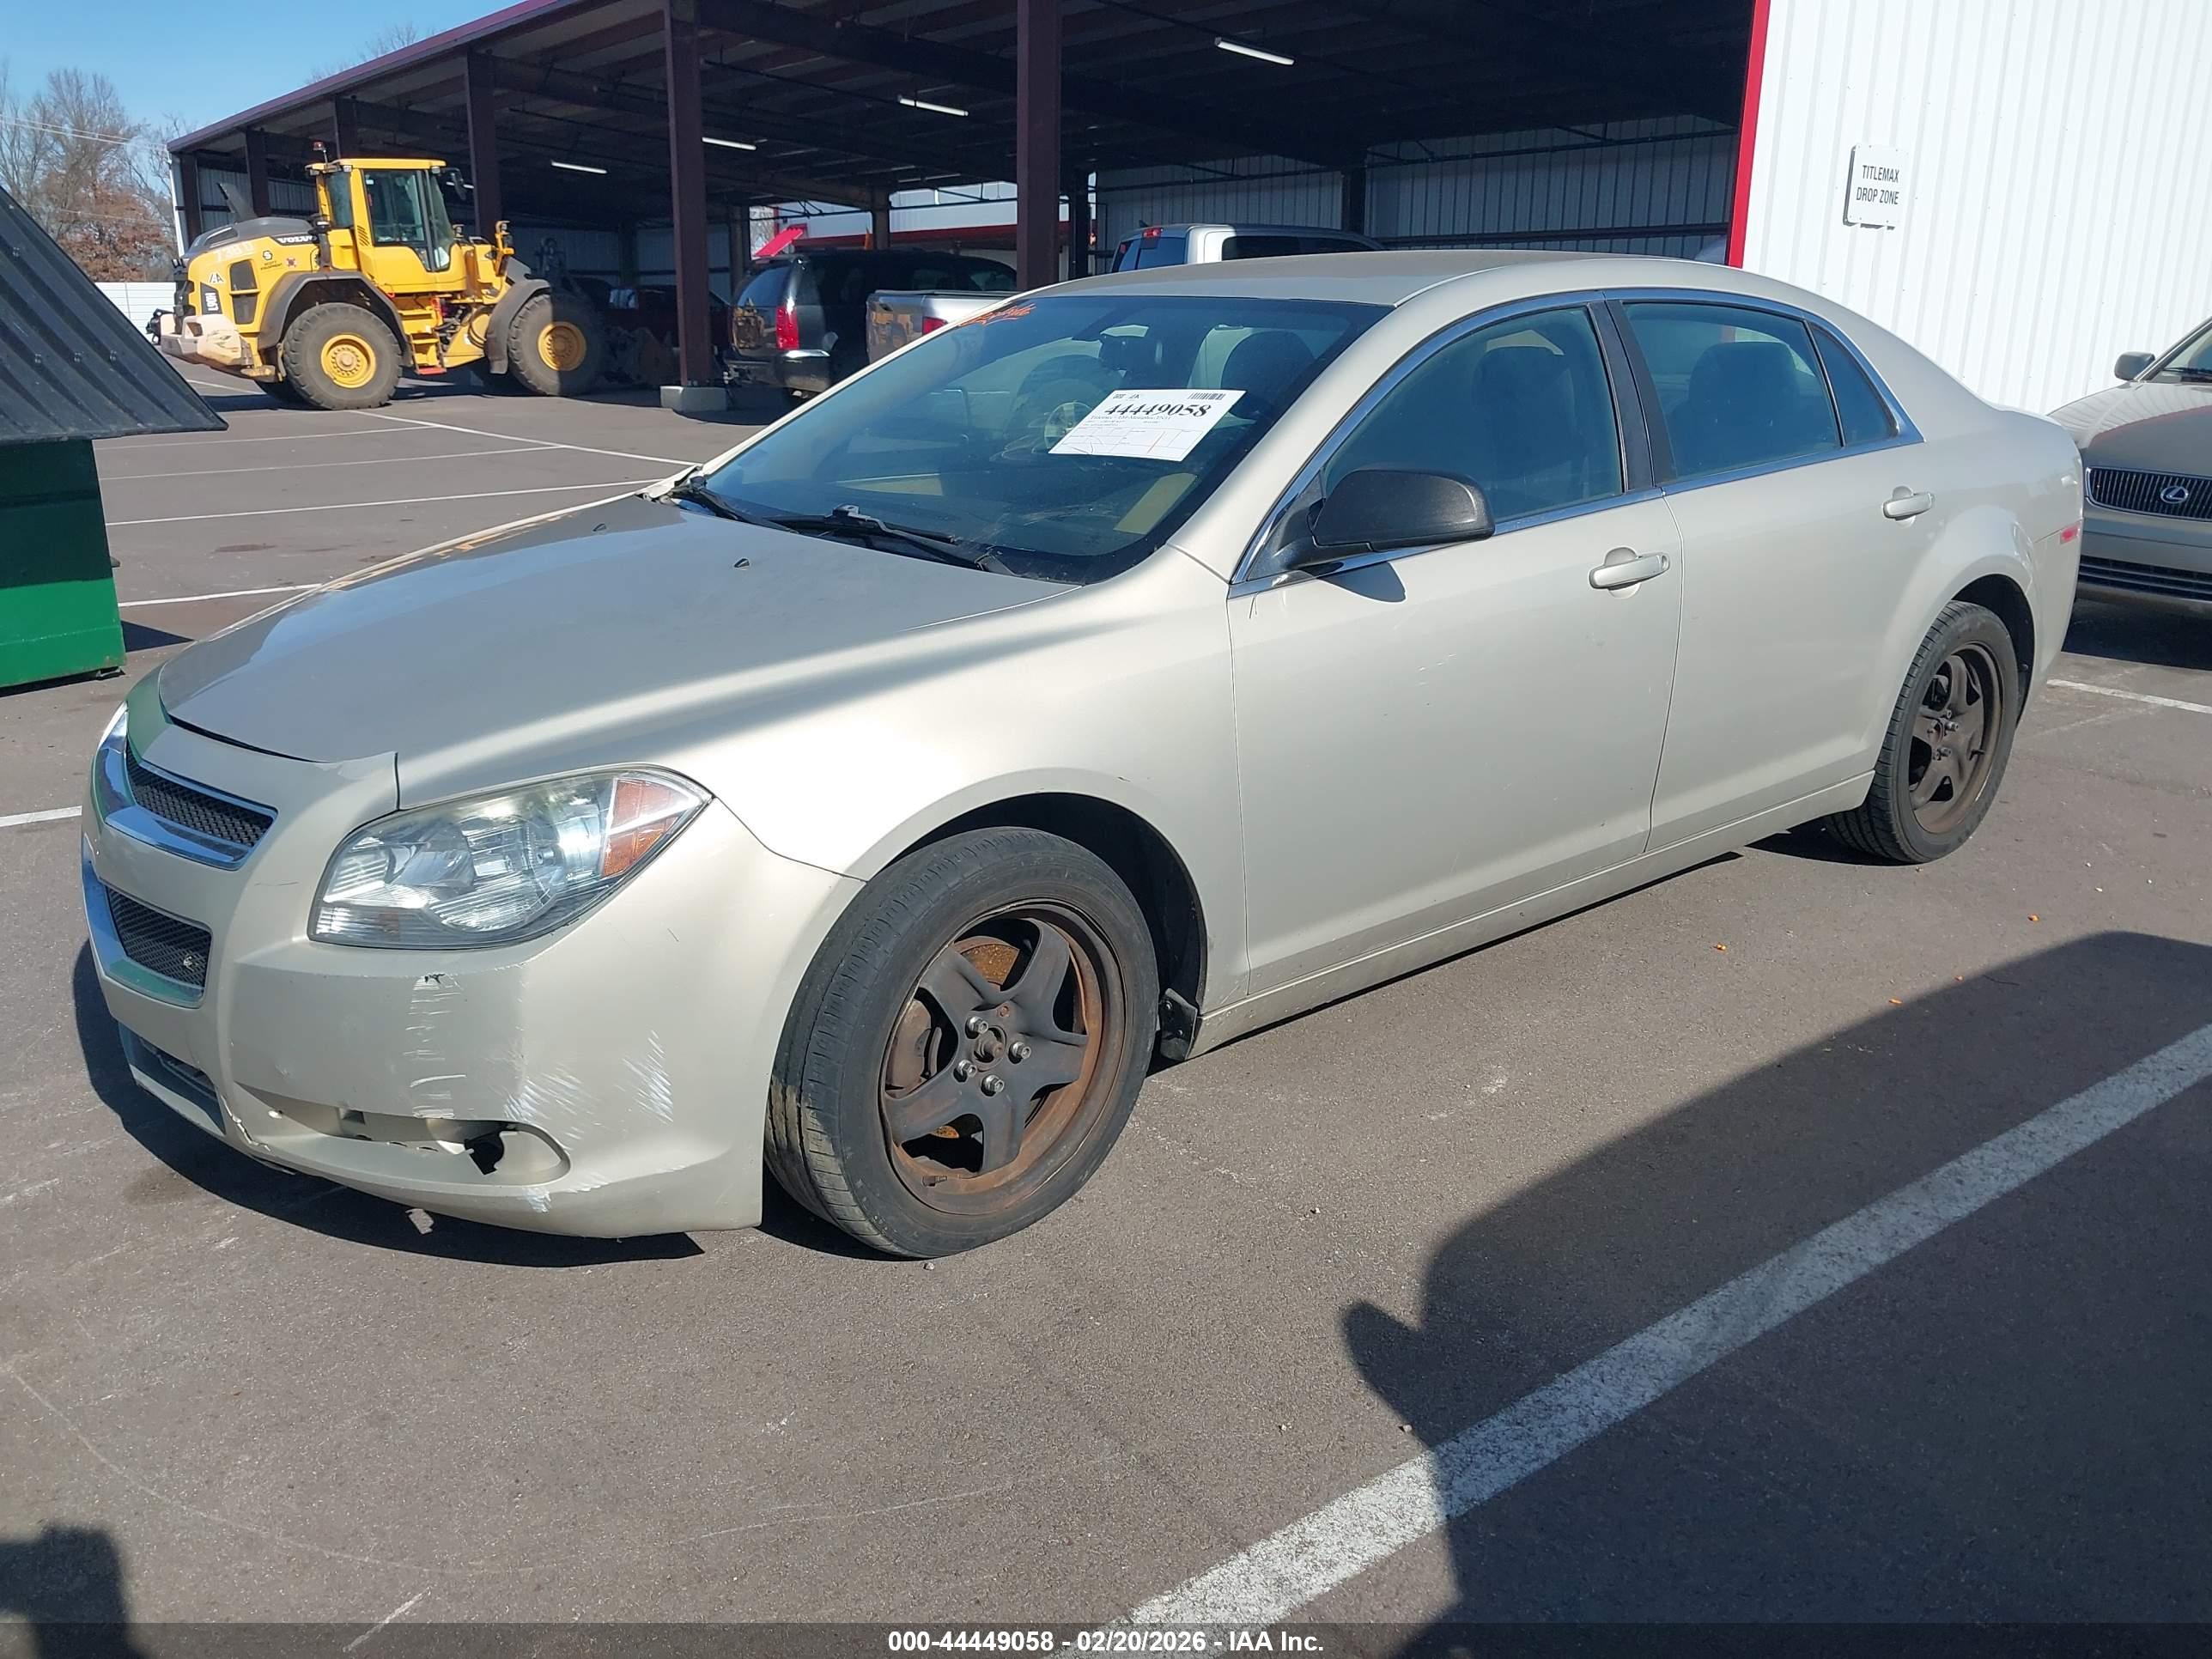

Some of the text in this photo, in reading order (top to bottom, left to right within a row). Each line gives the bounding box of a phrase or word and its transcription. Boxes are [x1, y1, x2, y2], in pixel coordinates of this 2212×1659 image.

[1862, 165, 1899, 183] TITLEMAX
[1856, 186, 1899, 204] DROP ZONE
[1104, 404, 1212, 417] 44449058
